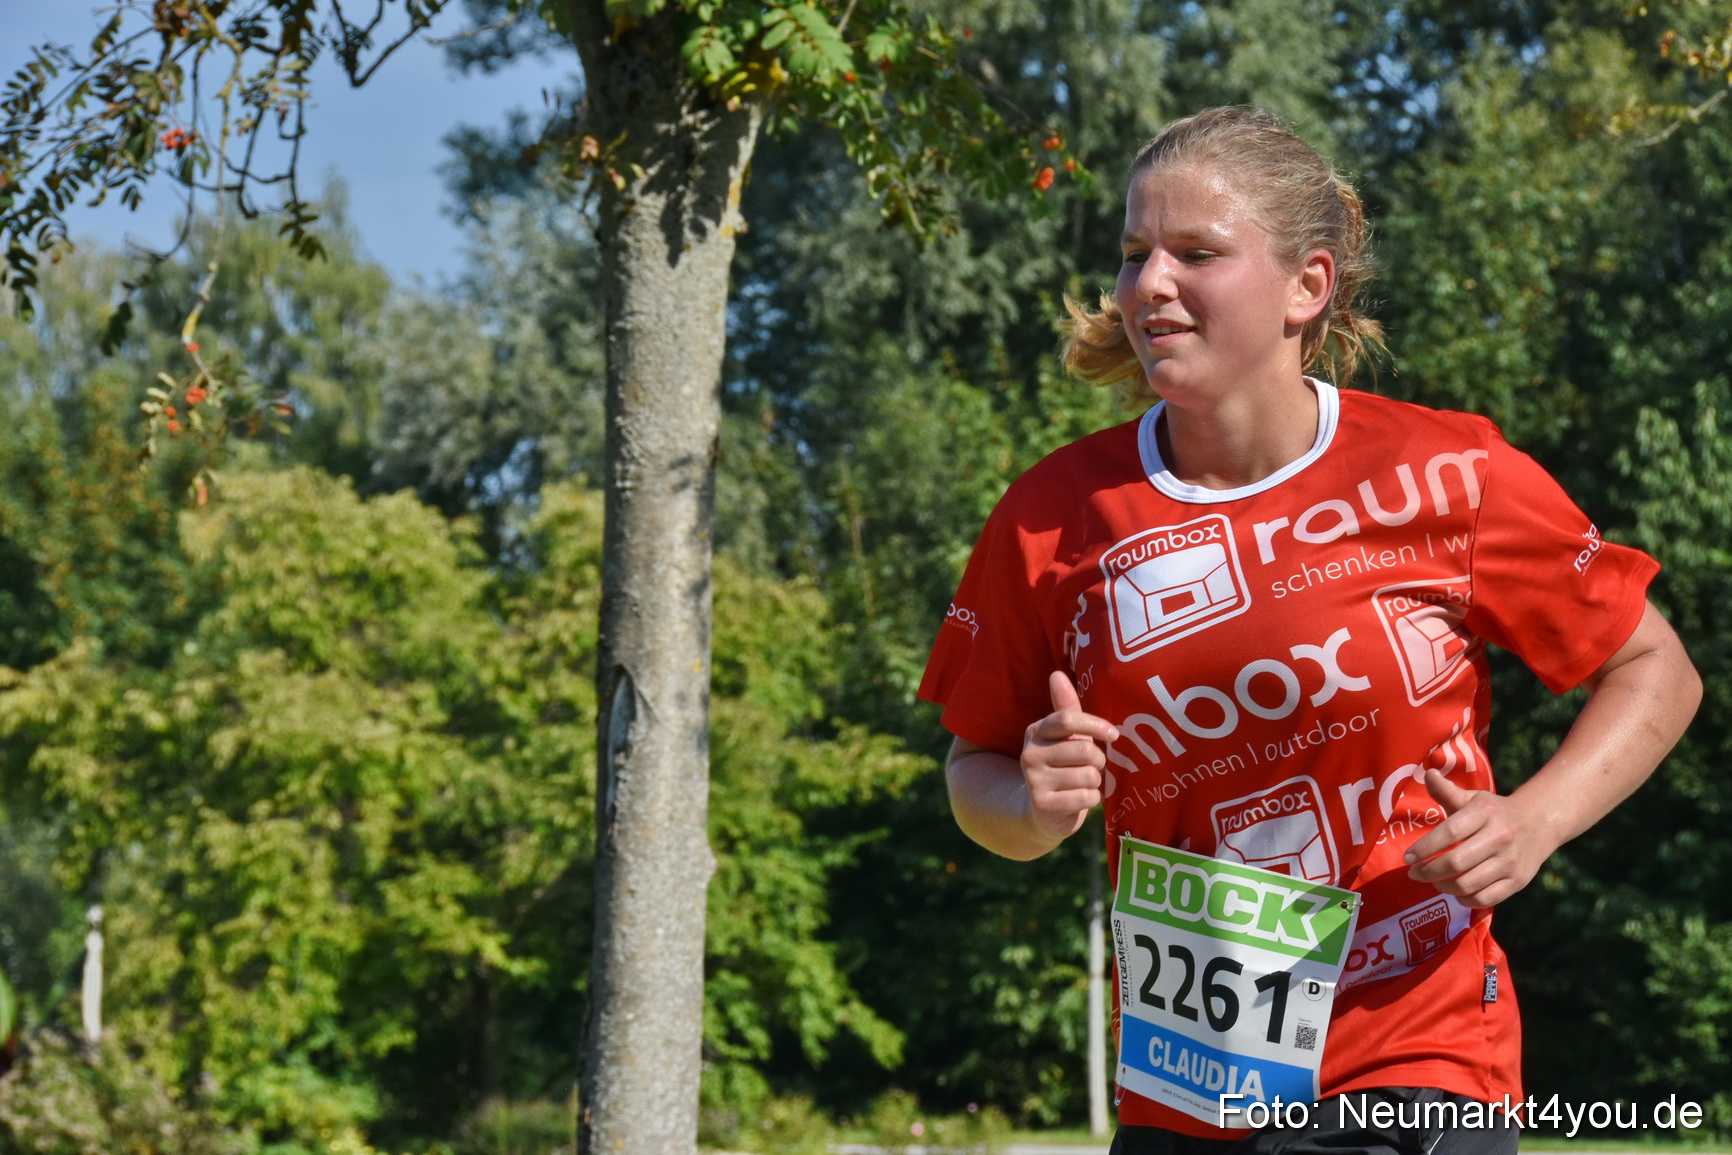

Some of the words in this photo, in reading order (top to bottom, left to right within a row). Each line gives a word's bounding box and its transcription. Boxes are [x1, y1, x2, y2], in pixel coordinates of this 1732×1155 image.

[1108, 523, 1222, 575] raumbox
[1271, 546, 1417, 599] schenken
[1443, 533, 1474, 553] w
[1105, 627, 1371, 798] mbox
[1146, 753, 1246, 803] wohnen
[1265, 708, 1380, 762] outdoor
[1221, 791, 1311, 835] raumbox
[1131, 852, 1328, 949] BOCK
[1405, 905, 1446, 930] raumbox
[1133, 934, 1293, 1044] 2261
[1308, 981, 1321, 996] D
[1148, 1036, 1266, 1103] CLAUDIA
